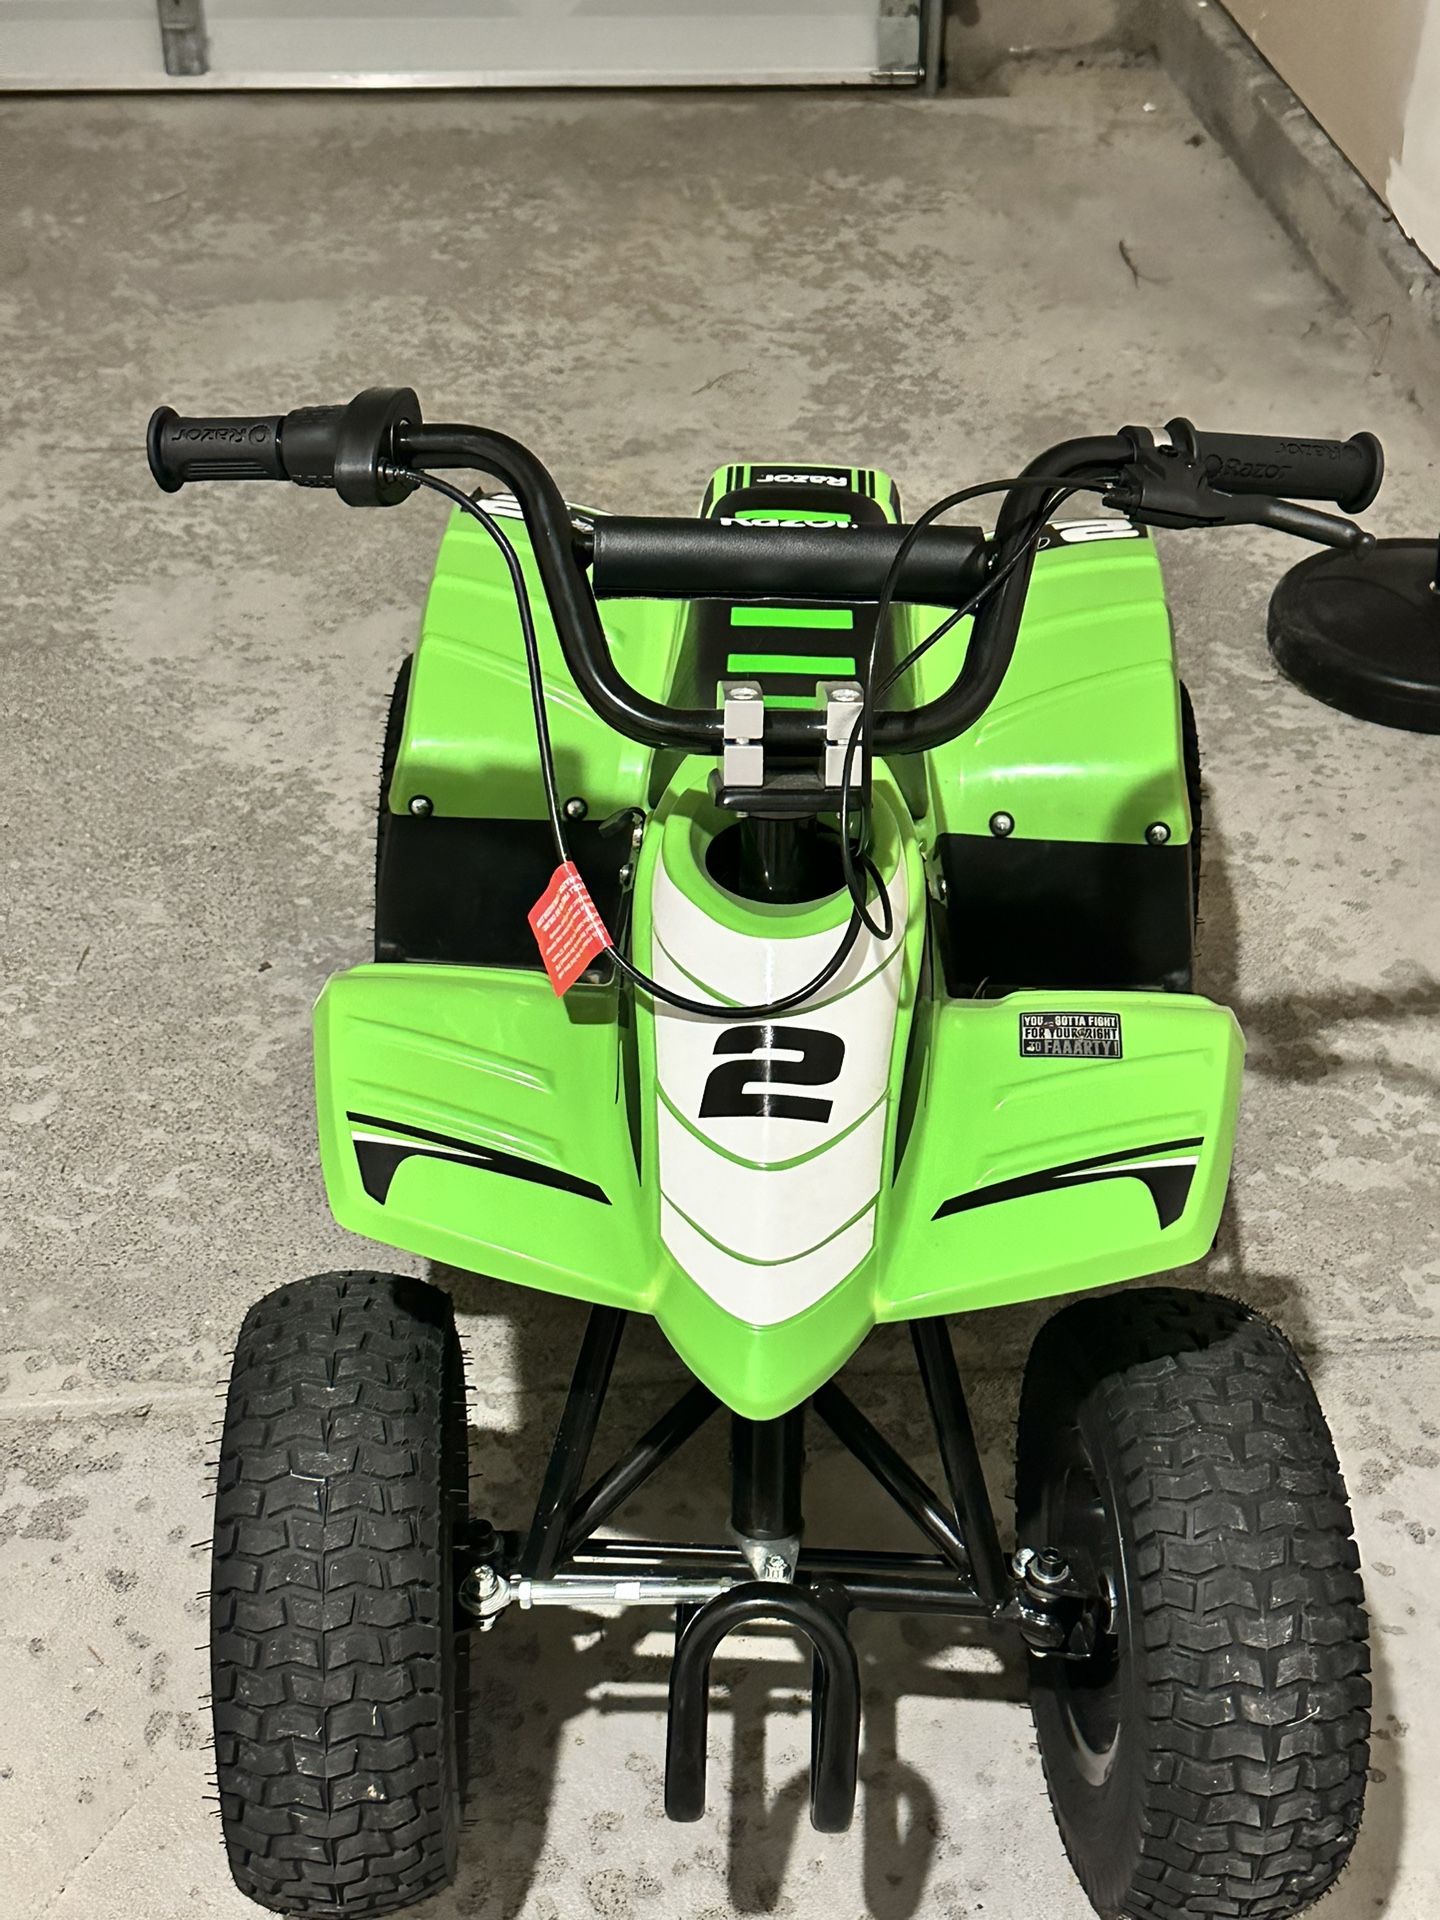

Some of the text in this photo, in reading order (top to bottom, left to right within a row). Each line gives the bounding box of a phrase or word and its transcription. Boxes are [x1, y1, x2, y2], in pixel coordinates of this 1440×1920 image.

[171, 427, 247, 444] Razor
[1223, 458, 1292, 480] Razor
[756, 474, 848, 487] Razor
[1024, 1016, 1116, 1027] YOU GOTTA FIGHT
[1025, 1028, 1117, 1039] FOR YOUR RIGHT
[698, 1024, 846, 1124] 2
